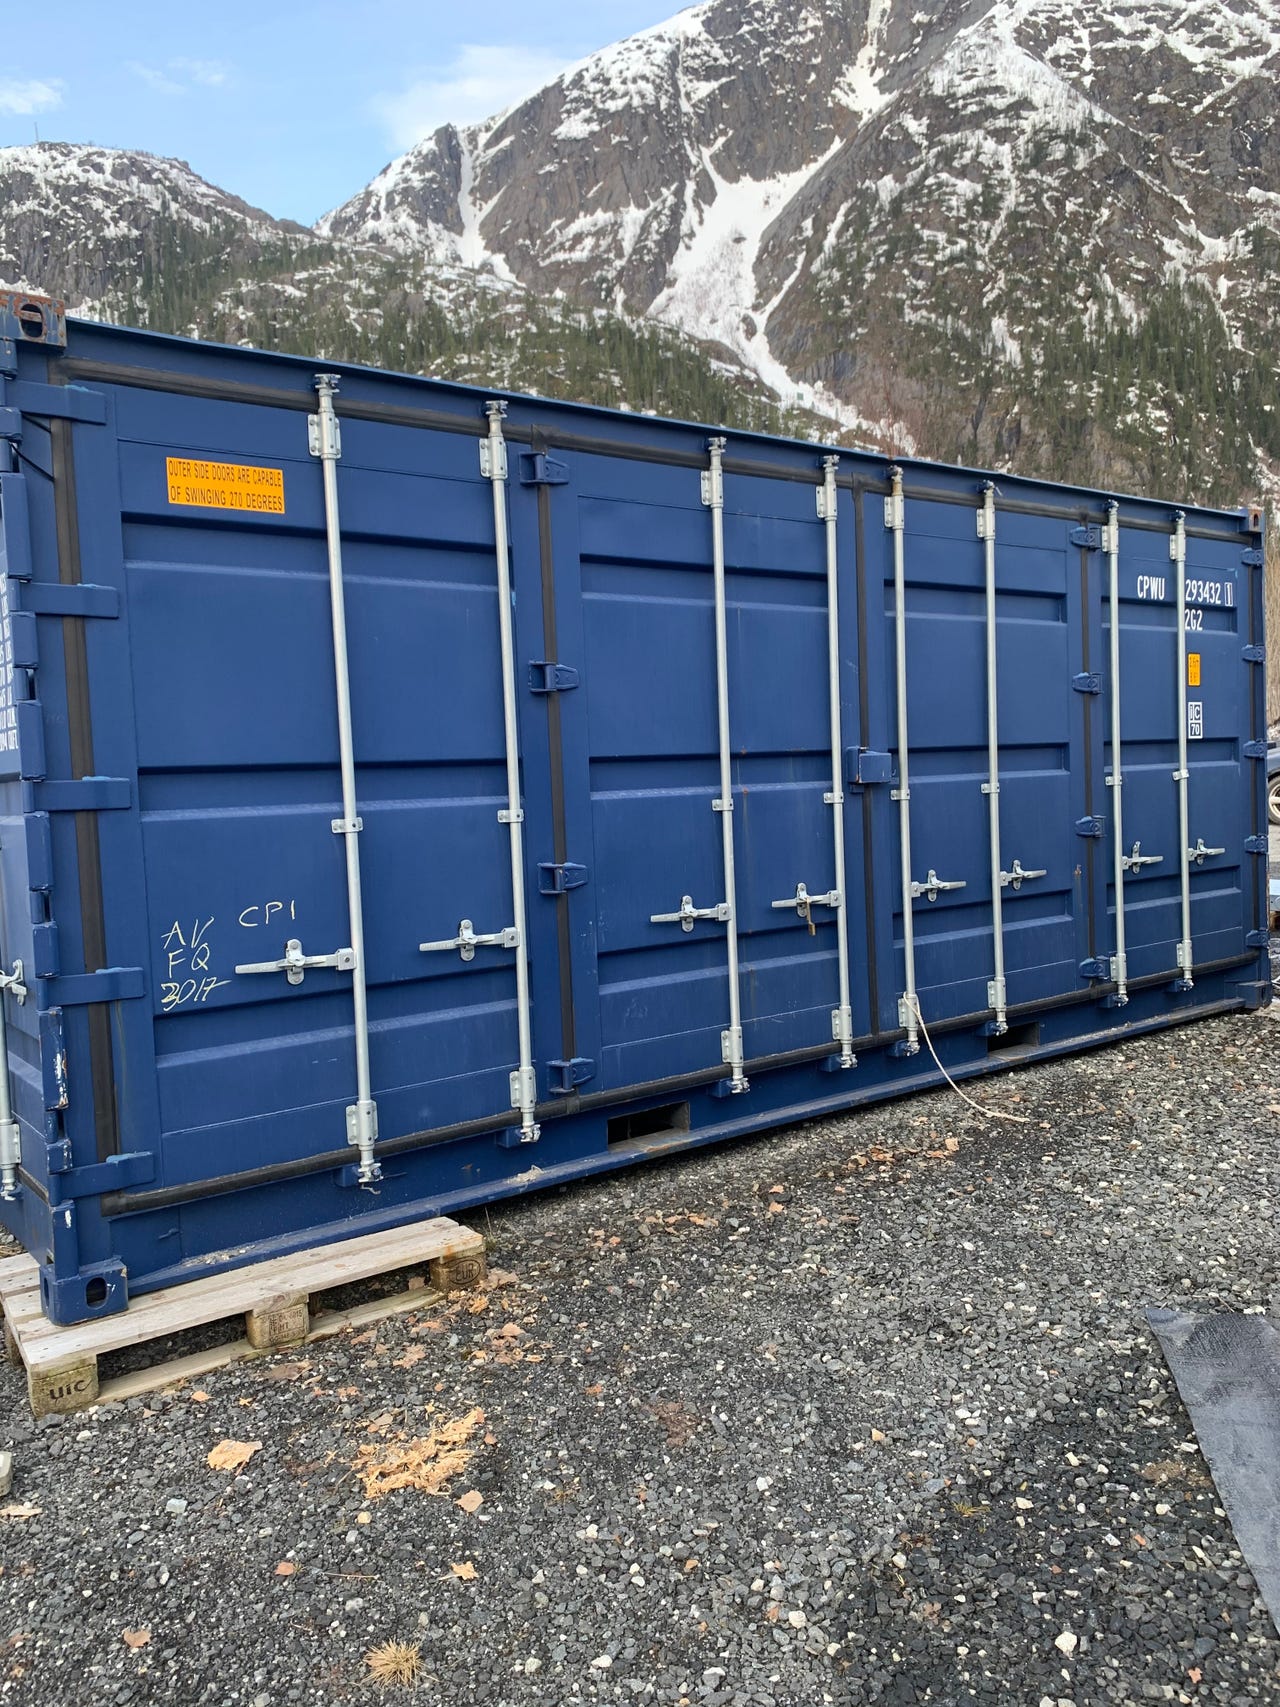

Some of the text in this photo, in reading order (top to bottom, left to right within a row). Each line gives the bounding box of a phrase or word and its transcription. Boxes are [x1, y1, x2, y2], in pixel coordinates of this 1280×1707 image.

[168, 460, 282, 487] OUTER SIDE DOORS ARE CAPABLE
[170, 485, 283, 511] OF SWINGING 270 DEGREES
[1137, 575, 1165, 600] CPWU
[1185, 579, 1221, 604] 293432
[1190, 723, 1201, 736] 70
